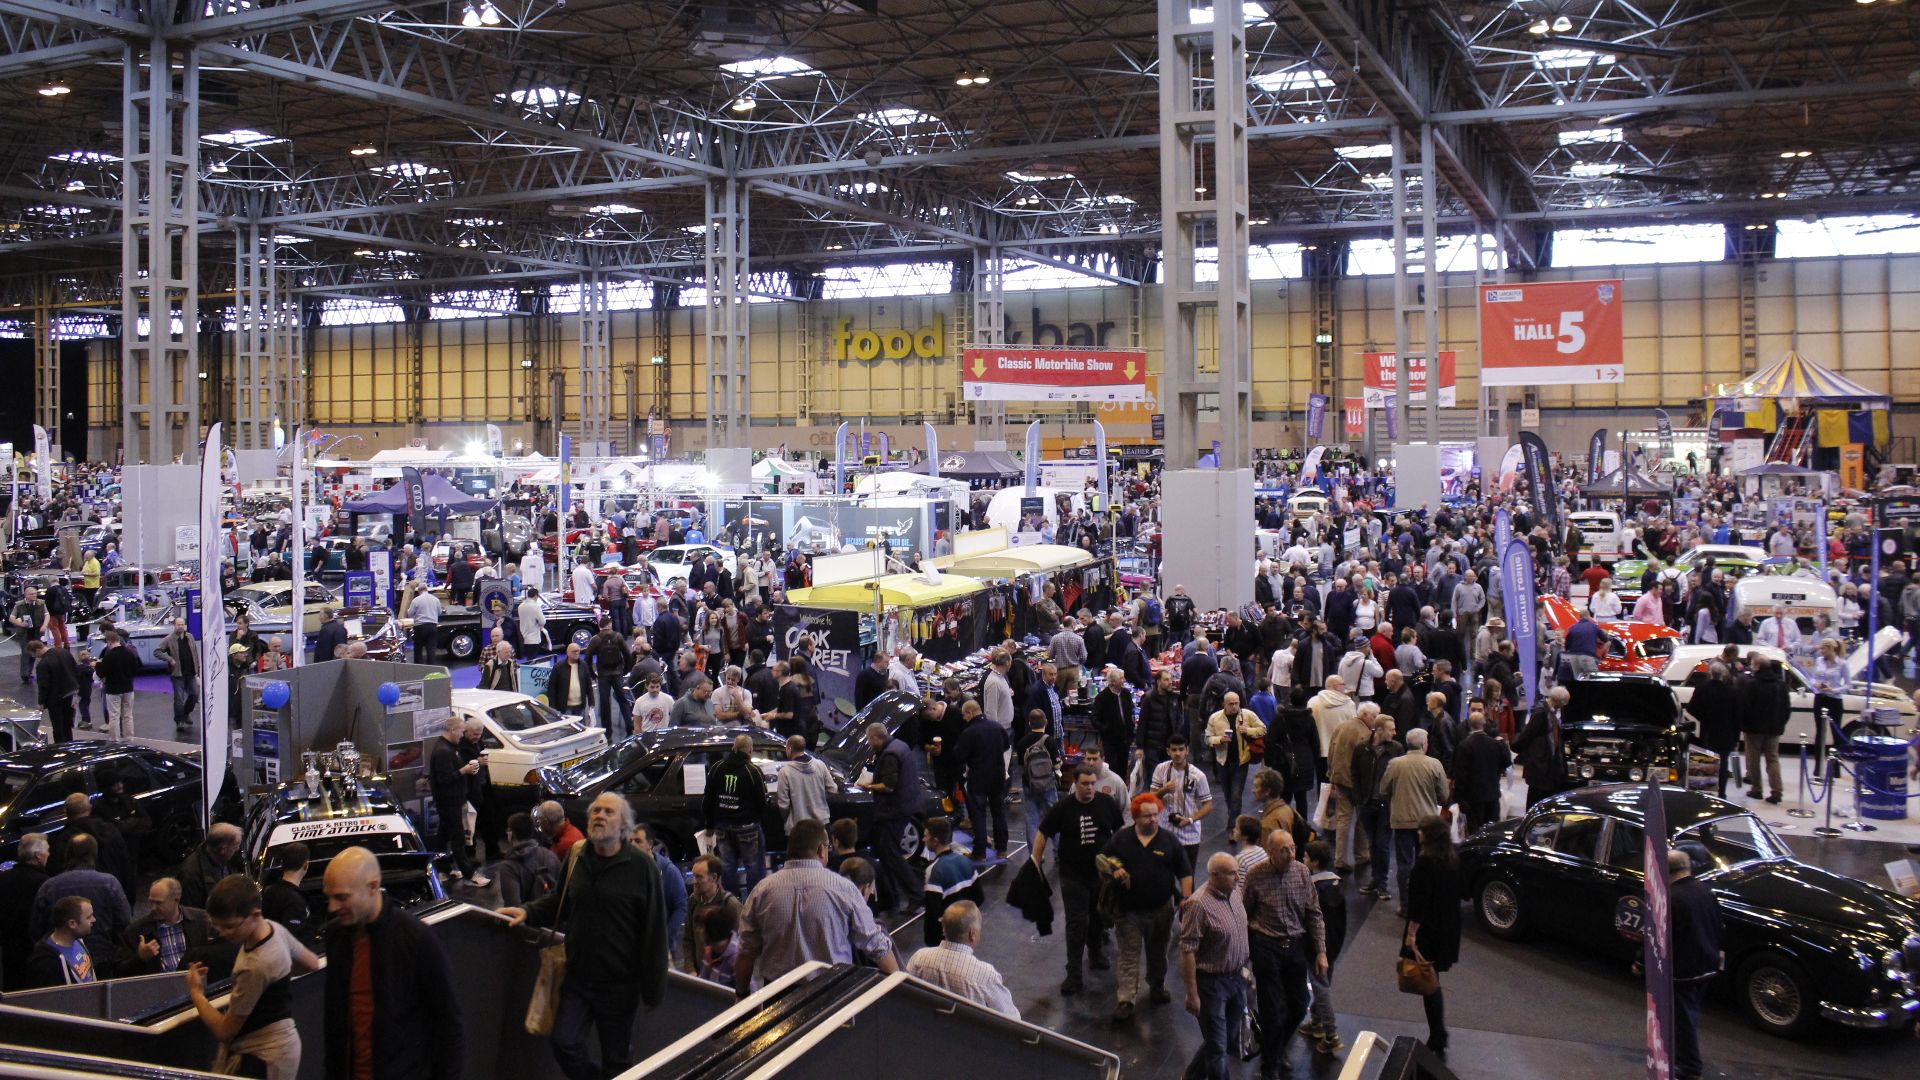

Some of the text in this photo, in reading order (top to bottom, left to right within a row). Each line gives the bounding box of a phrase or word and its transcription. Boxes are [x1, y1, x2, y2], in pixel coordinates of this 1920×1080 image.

[1031, 307, 1116, 347] bar
[1514, 311, 1586, 354] HALL 5
[832, 312, 944, 361] food
[997, 357, 1113, 371] Classic Motorbike Show
[1597, 368, 1606, 380] 1
[785, 626, 831, 650] COOK
[291, 824, 324, 833] CLASSIC
[333, 820, 358, 828] RETRO
[392, 834, 403, 849] 1
[1623, 911, 1641, 928] 27
